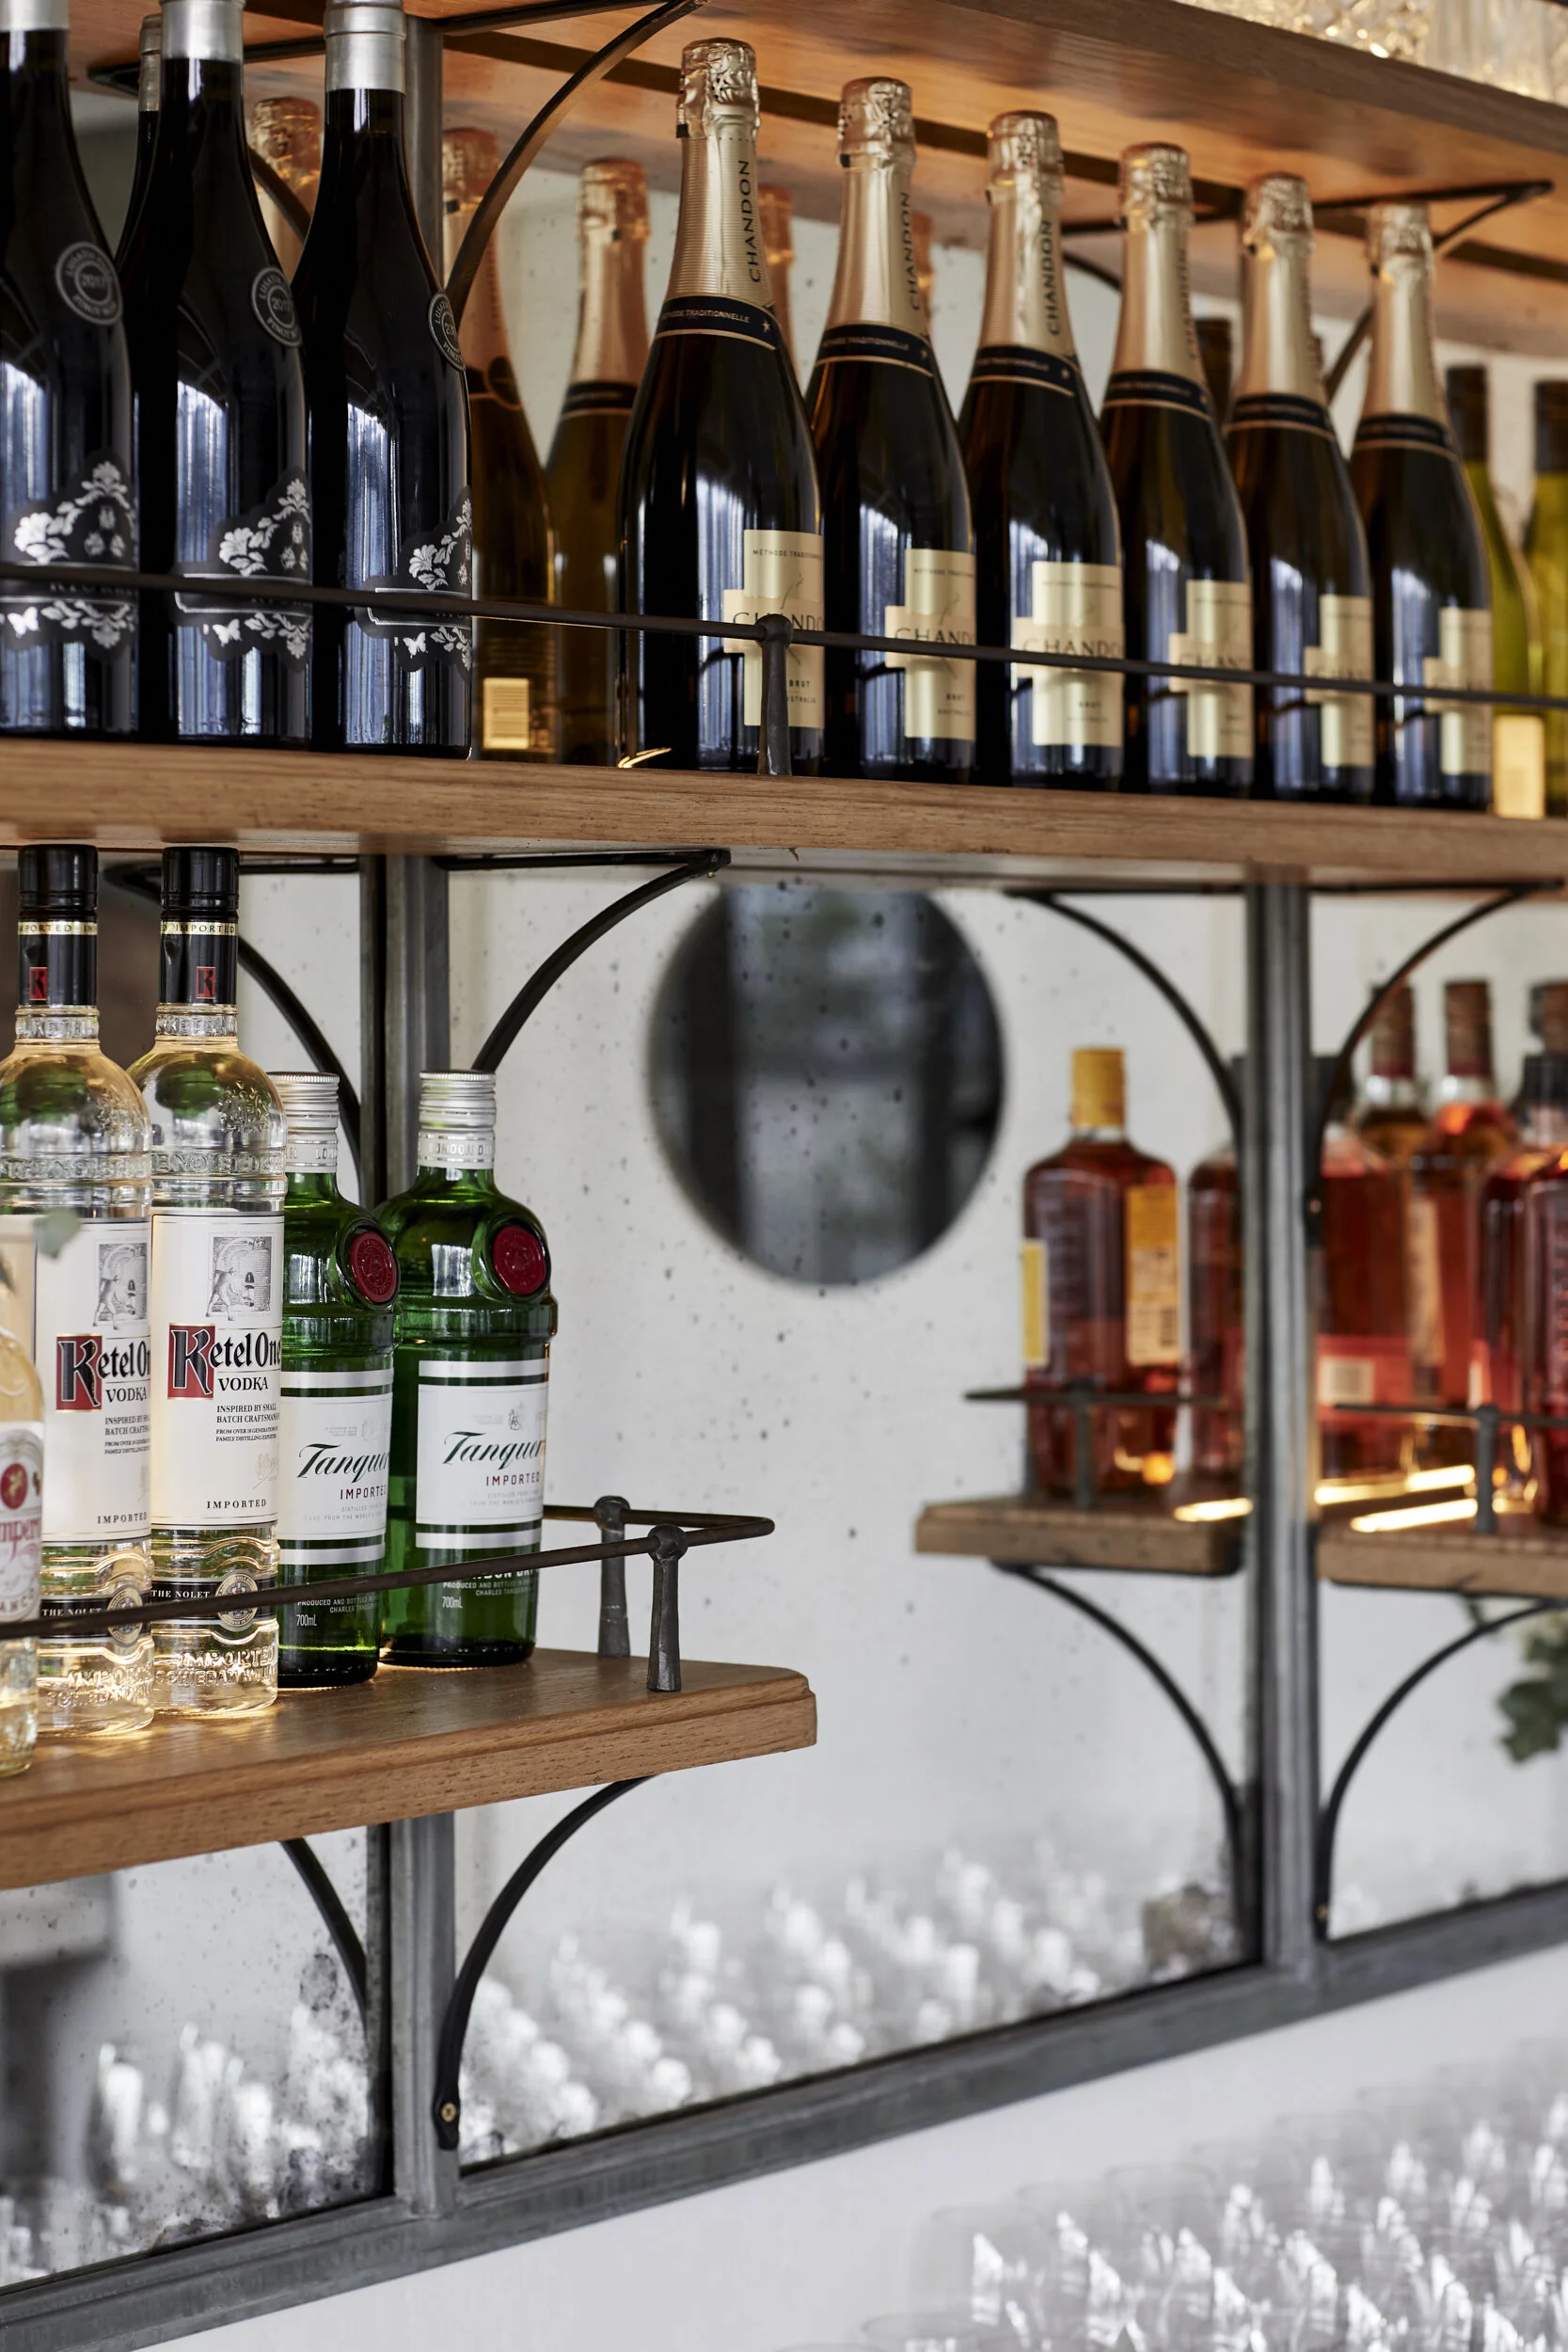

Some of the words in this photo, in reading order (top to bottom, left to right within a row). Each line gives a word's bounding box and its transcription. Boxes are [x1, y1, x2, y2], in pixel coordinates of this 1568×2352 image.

[737, 160, 761, 283] CHANDON
[900, 191, 921, 312] CHANDON
[1041, 219, 1061, 336] CHANDON
[685, 309, 751, 324] TRADITIONNELLE
[789, 679, 811, 688] BRUT
[176, 925, 235, 933] IMPORTED
[170, 1328, 252, 1395] Ketel
[255, 1331, 281, 1368] One
[57, 1339, 135, 1407] Ketel
[217, 1376, 269, 1391] VODKA
[105, 1386, 148, 1403] VODKA
[216, 1405, 253, 1413] INSPIRED
[254, 1404, 262, 1412] BY
[105, 1416, 136, 1425] INSPIRED
[216, 1415, 243, 1423] BATCH
[105, 1426, 129, 1436] BATCH
[485, 1471, 540, 1486] IMPORTED
[206, 1499, 267, 1508] IMPORTED
[97, 1511, 148, 1524] IMPORTED
[151, 1589, 172, 1597] THE
[174, 1590, 211, 1598] NOLET
[329, 1605, 355, 1613] CHARLES
[442, 1596, 464, 1609] 700mL
[42, 1608, 64, 1616] THE
[296, 1613, 318, 1627] 700mL
